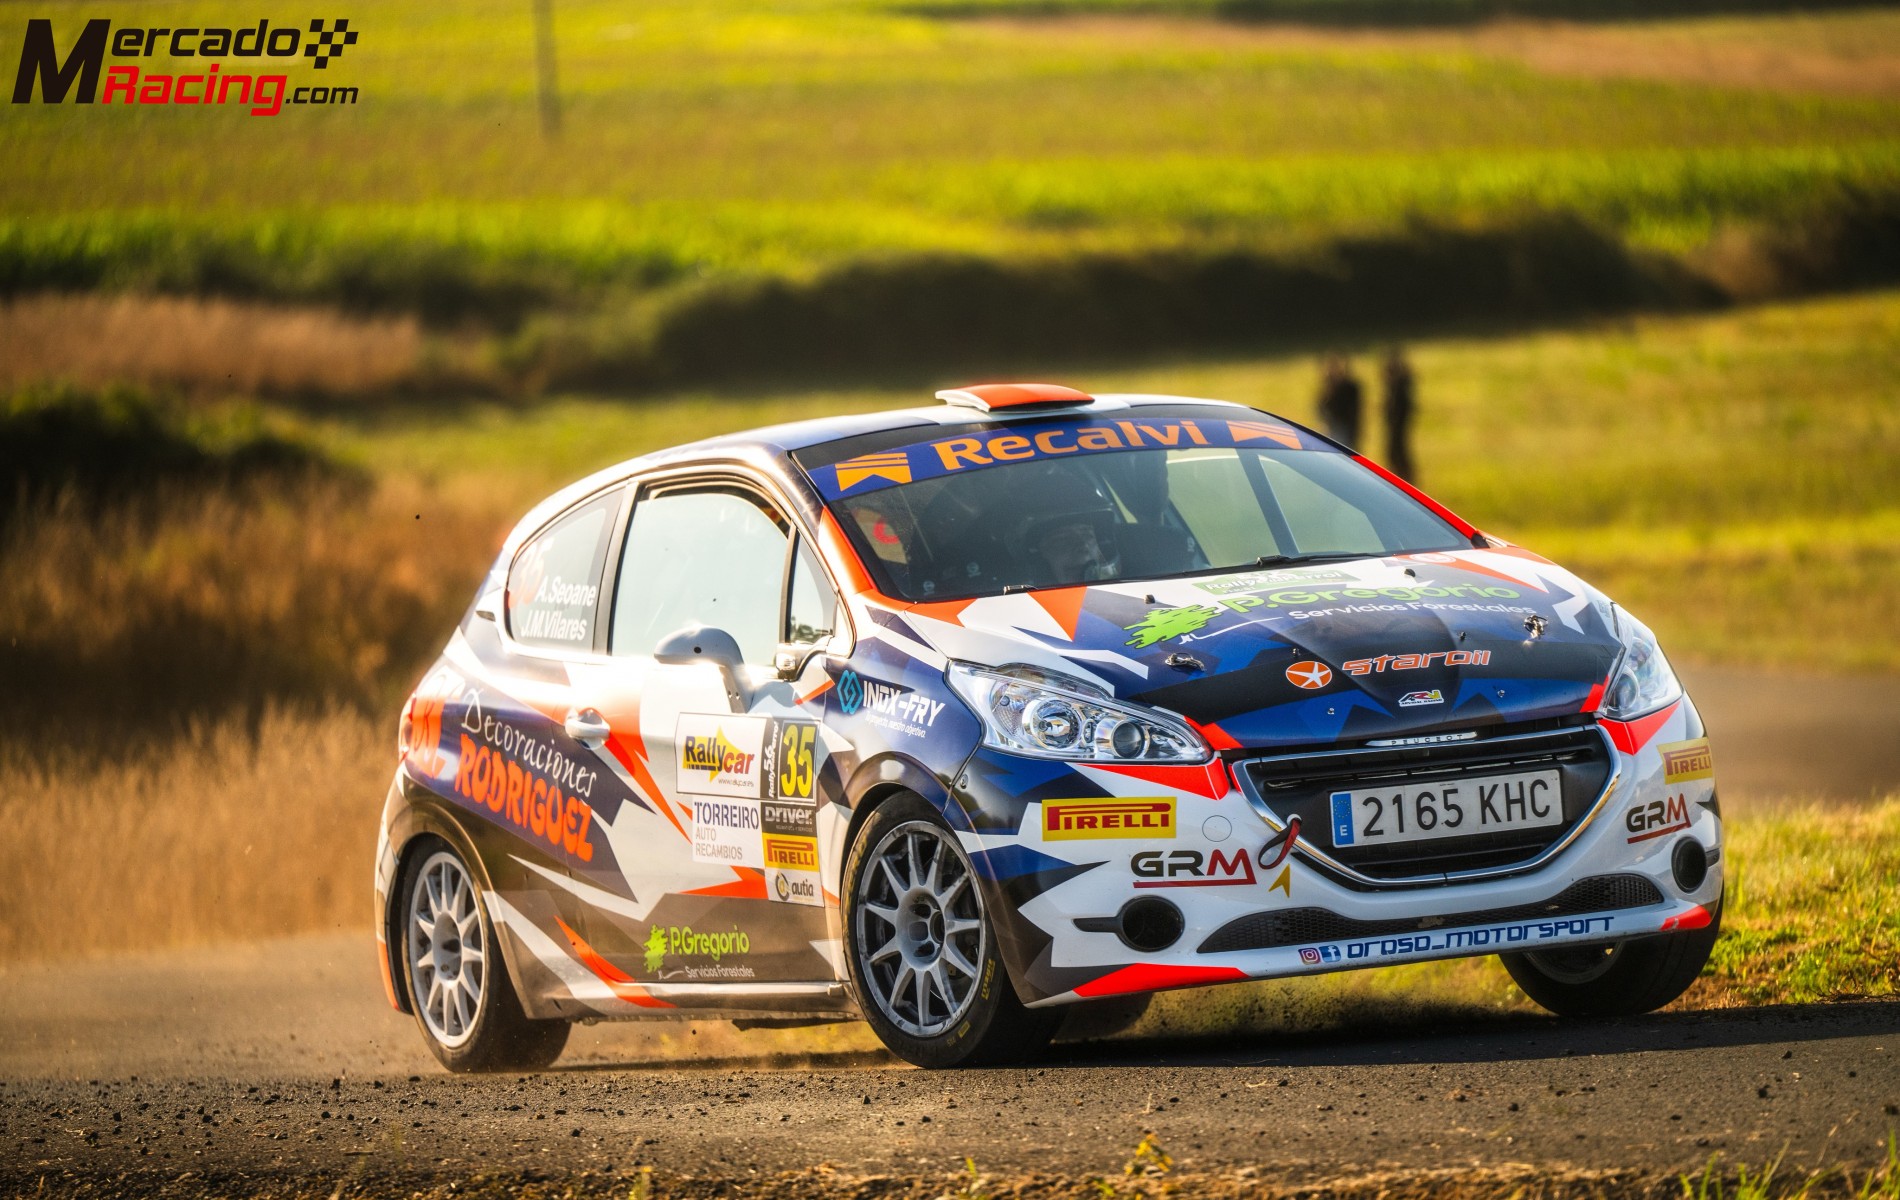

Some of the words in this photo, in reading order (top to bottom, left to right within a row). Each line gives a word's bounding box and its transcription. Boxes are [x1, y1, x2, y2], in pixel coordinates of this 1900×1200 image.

[930, 420, 1212, 471] Recalvi
[535, 576, 597, 607] A.Seoane
[1218, 583, 1521, 613] P.Gregorio
[521, 610, 588, 640] J.M.Vilares
[1288, 603, 1408, 619] Servicios
[1406, 602, 1538, 614] Forestales
[863, 680, 946, 727] INOX-FRY
[461, 688, 597, 797] Decoraciones
[1391, 735, 1463, 746] PEUGEOT
[781, 724, 816, 797] 35
[1663, 745, 1712, 776] PIRELLI
[455, 733, 593, 862] RODRIGUEZ
[1362, 788, 1463, 837] 2165
[1479, 779, 1551, 825] KHC
[694, 801, 760, 830] TORREIRO
[1047, 803, 1171, 831] PIRELLI
[1626, 793, 1692, 833] GRM
[695, 827, 717, 842] AUTO
[1339, 824, 1348, 836] E
[696, 843, 743, 861] RECAMBIOS
[767, 839, 815, 866] PIRELLI
[1130, 848, 1257, 885] GRM
[791, 878, 814, 897] autia
[670, 925, 750, 961] P.Gregorio
[685, 966, 717, 978] Servicios
[717, 965, 755, 978] Forestales
